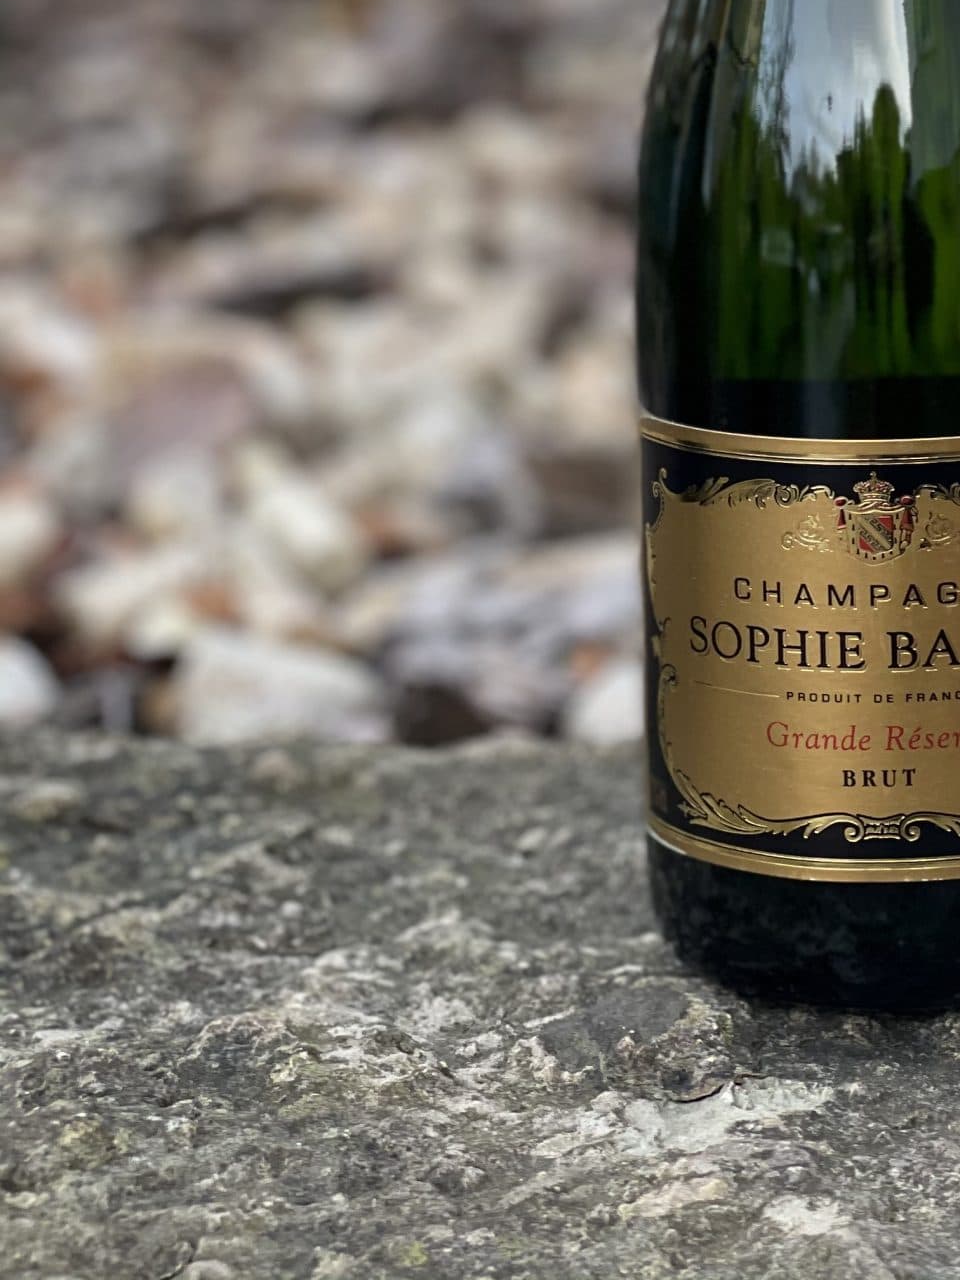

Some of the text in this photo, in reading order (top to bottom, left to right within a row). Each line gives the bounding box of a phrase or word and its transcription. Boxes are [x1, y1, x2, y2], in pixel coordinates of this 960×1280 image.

[690, 615, 866, 669] SOPHIE
[786, 690, 863, 704] PRODUIT
[873, 693, 895, 704] DE
[766, 721, 872, 752] Grande
[842, 768, 918, 788] BRUT
